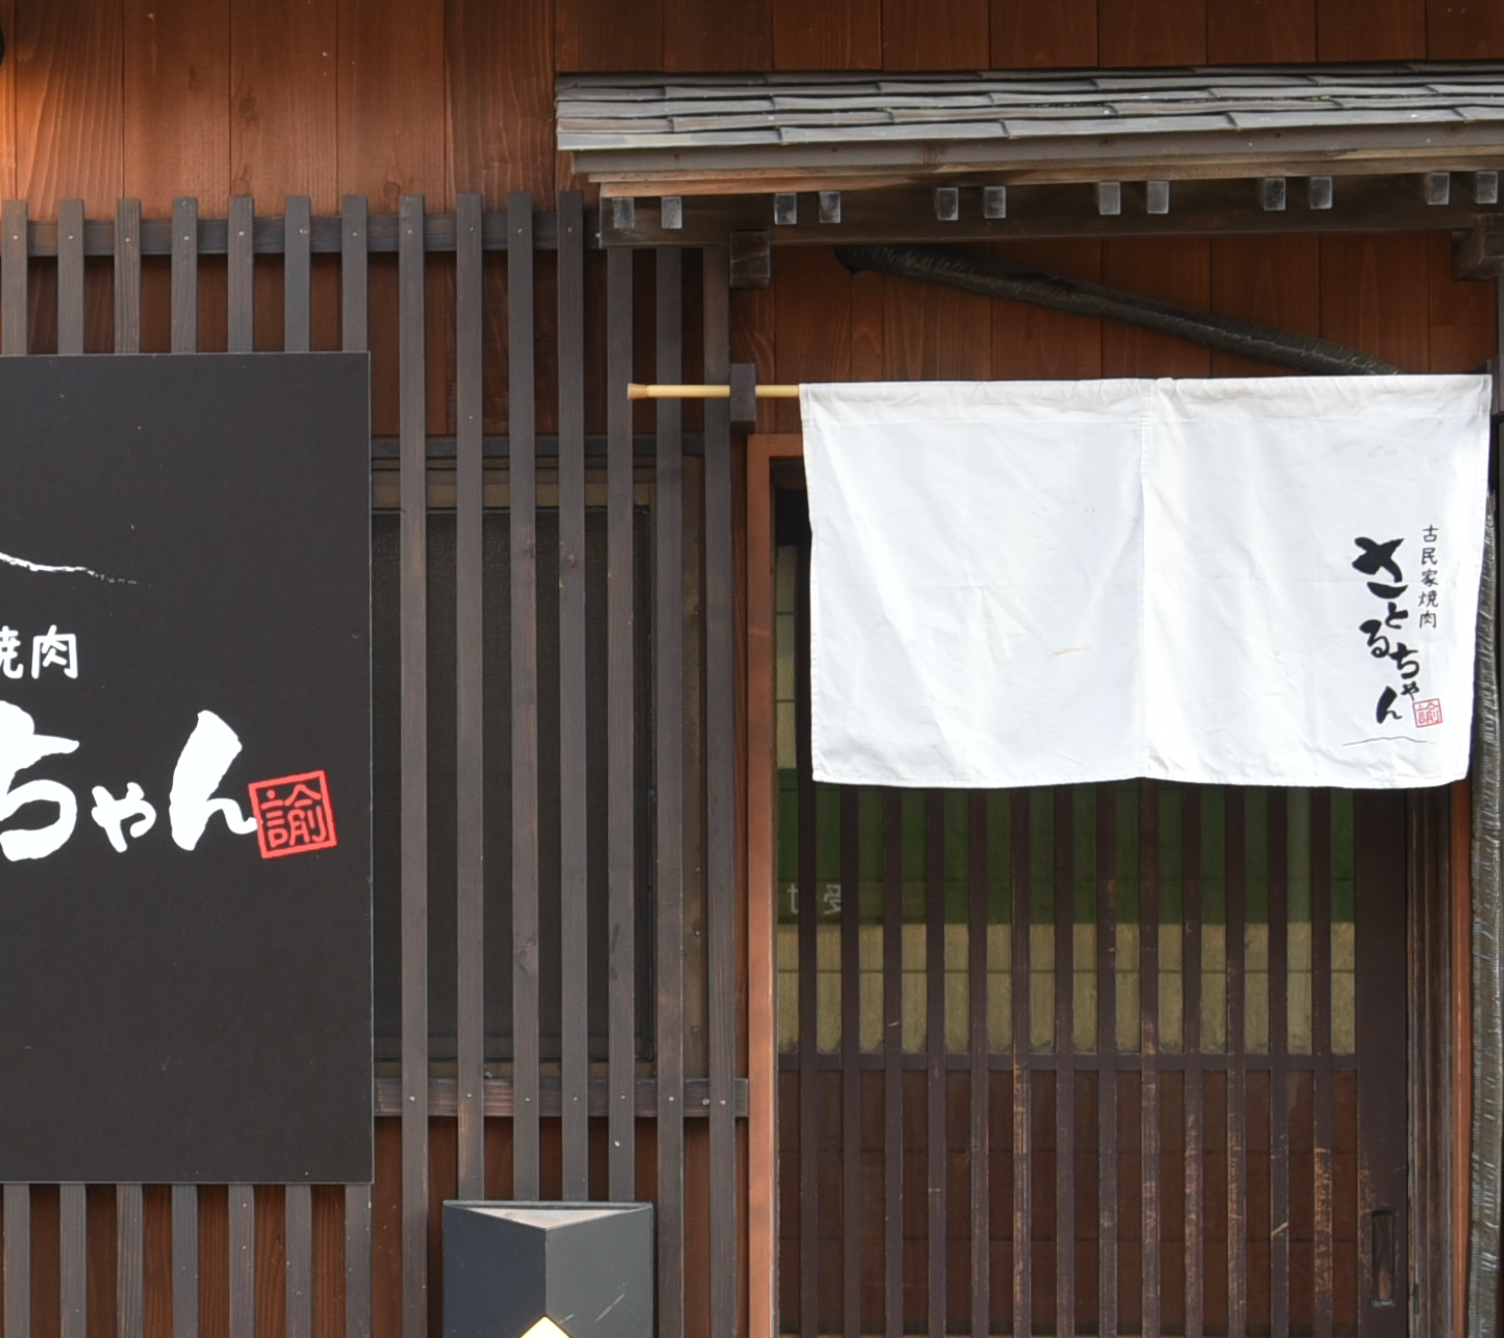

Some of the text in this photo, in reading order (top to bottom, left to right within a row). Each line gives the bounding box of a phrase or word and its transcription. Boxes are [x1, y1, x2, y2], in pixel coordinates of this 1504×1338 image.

[1352, 536, 1420, 725] さとるちゃん
[1418, 525, 1439, 629] 古民家焼肉
